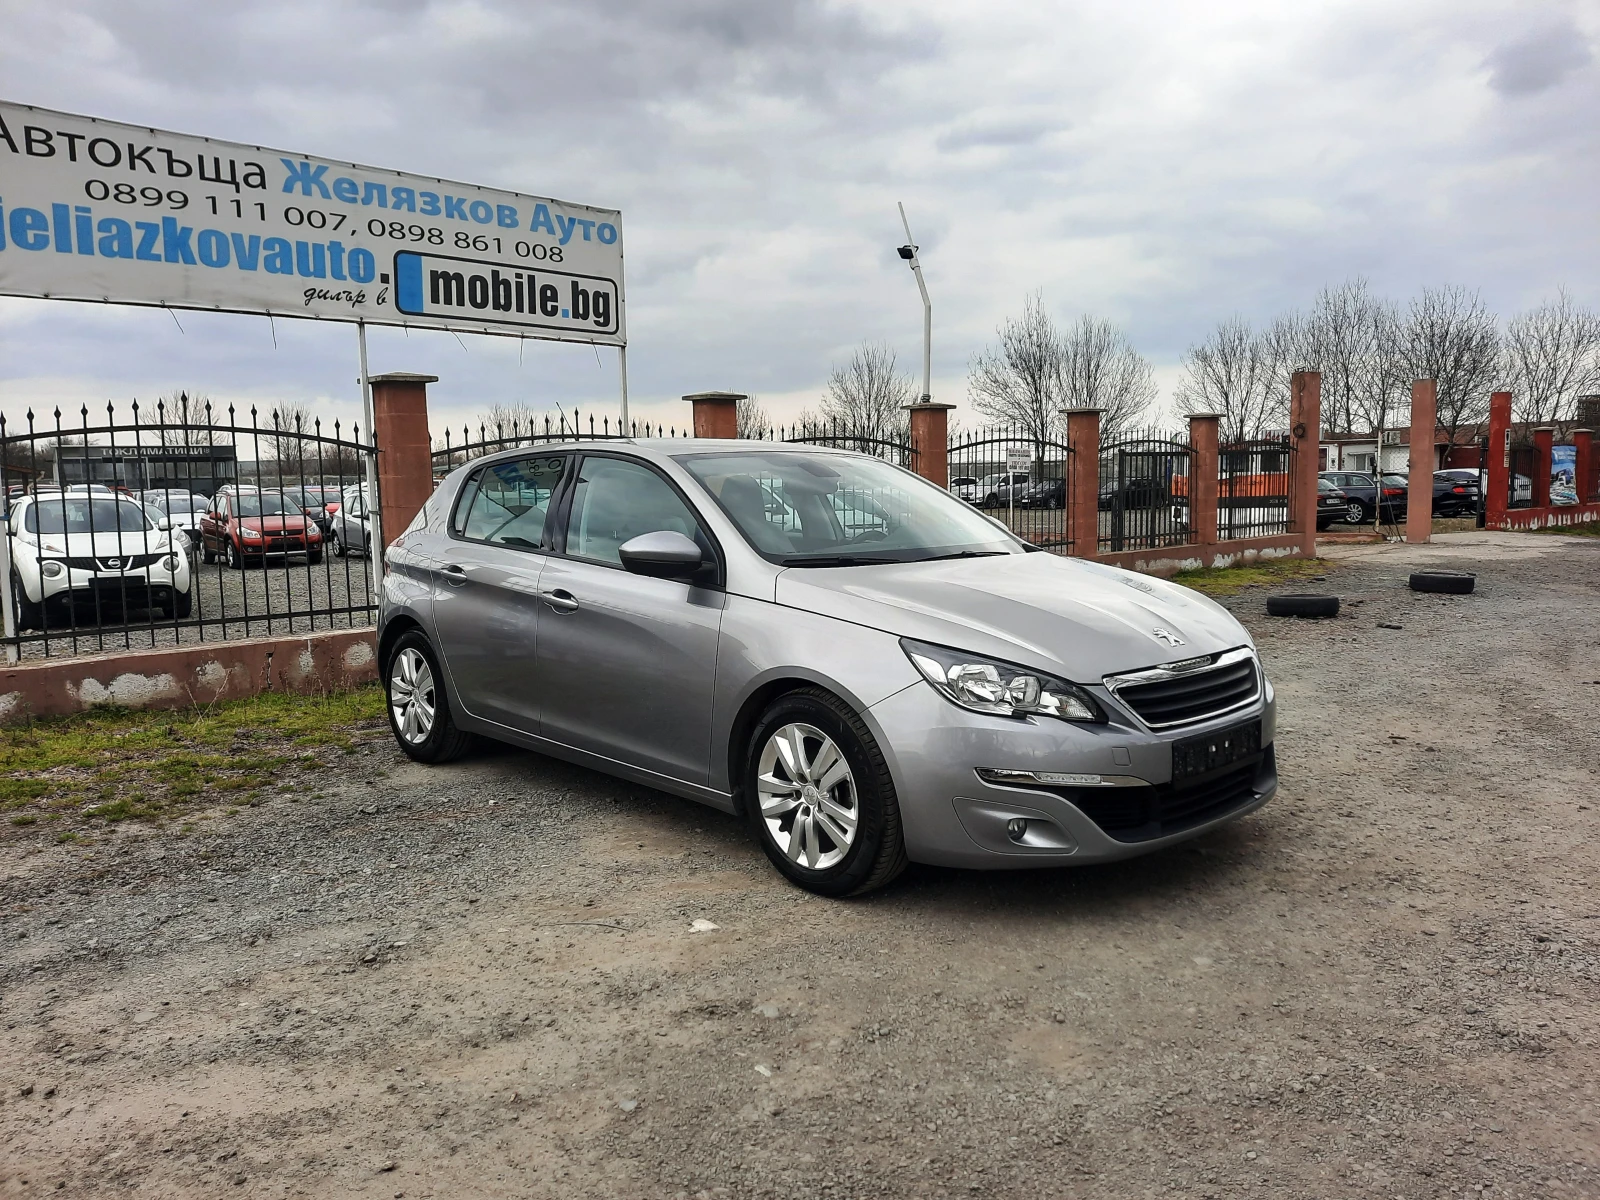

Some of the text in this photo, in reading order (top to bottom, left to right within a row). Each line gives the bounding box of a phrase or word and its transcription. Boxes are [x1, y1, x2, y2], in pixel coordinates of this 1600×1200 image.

[85, 179, 563, 263] 0899 111 007, 0898 861 008
[281, 158, 519, 229] Желязков
[530, 203, 617, 245] Ауто
[430, 269, 610, 328] mobile.bg
